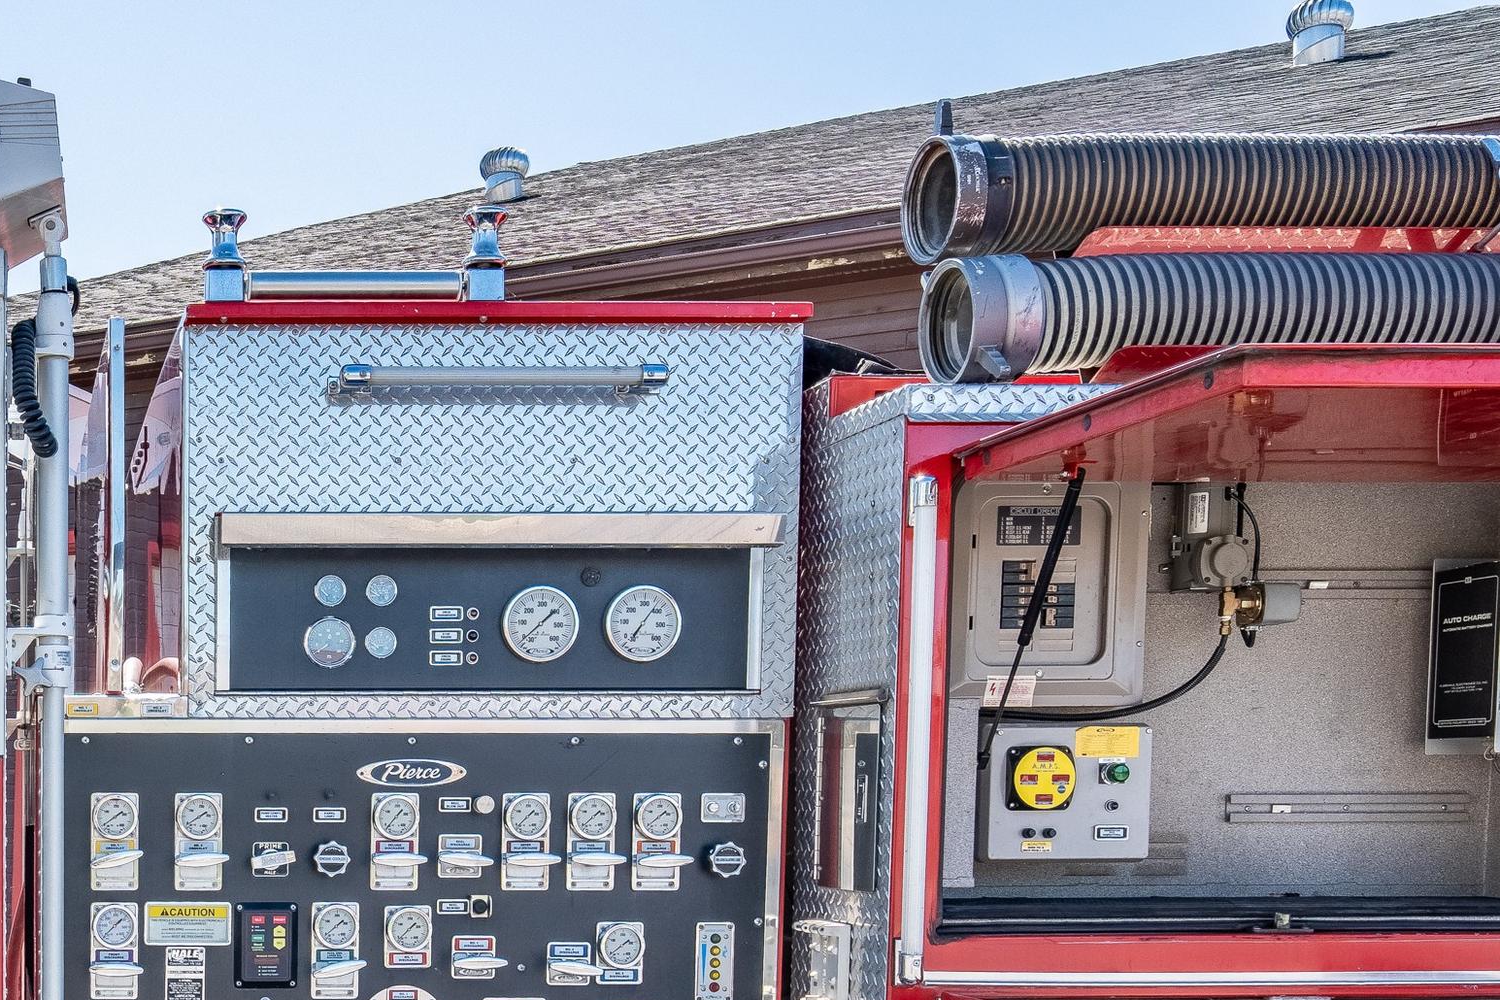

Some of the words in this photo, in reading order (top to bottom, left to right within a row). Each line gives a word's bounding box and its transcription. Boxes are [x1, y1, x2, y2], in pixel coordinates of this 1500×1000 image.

[1443, 616, 1461, 624] AUTO
[1463, 612, 1492, 622] CHARGE
[381, 763, 441, 782] Pierce
[169, 908, 215, 916] CAUTION
[172, 949, 199, 958] HALE
